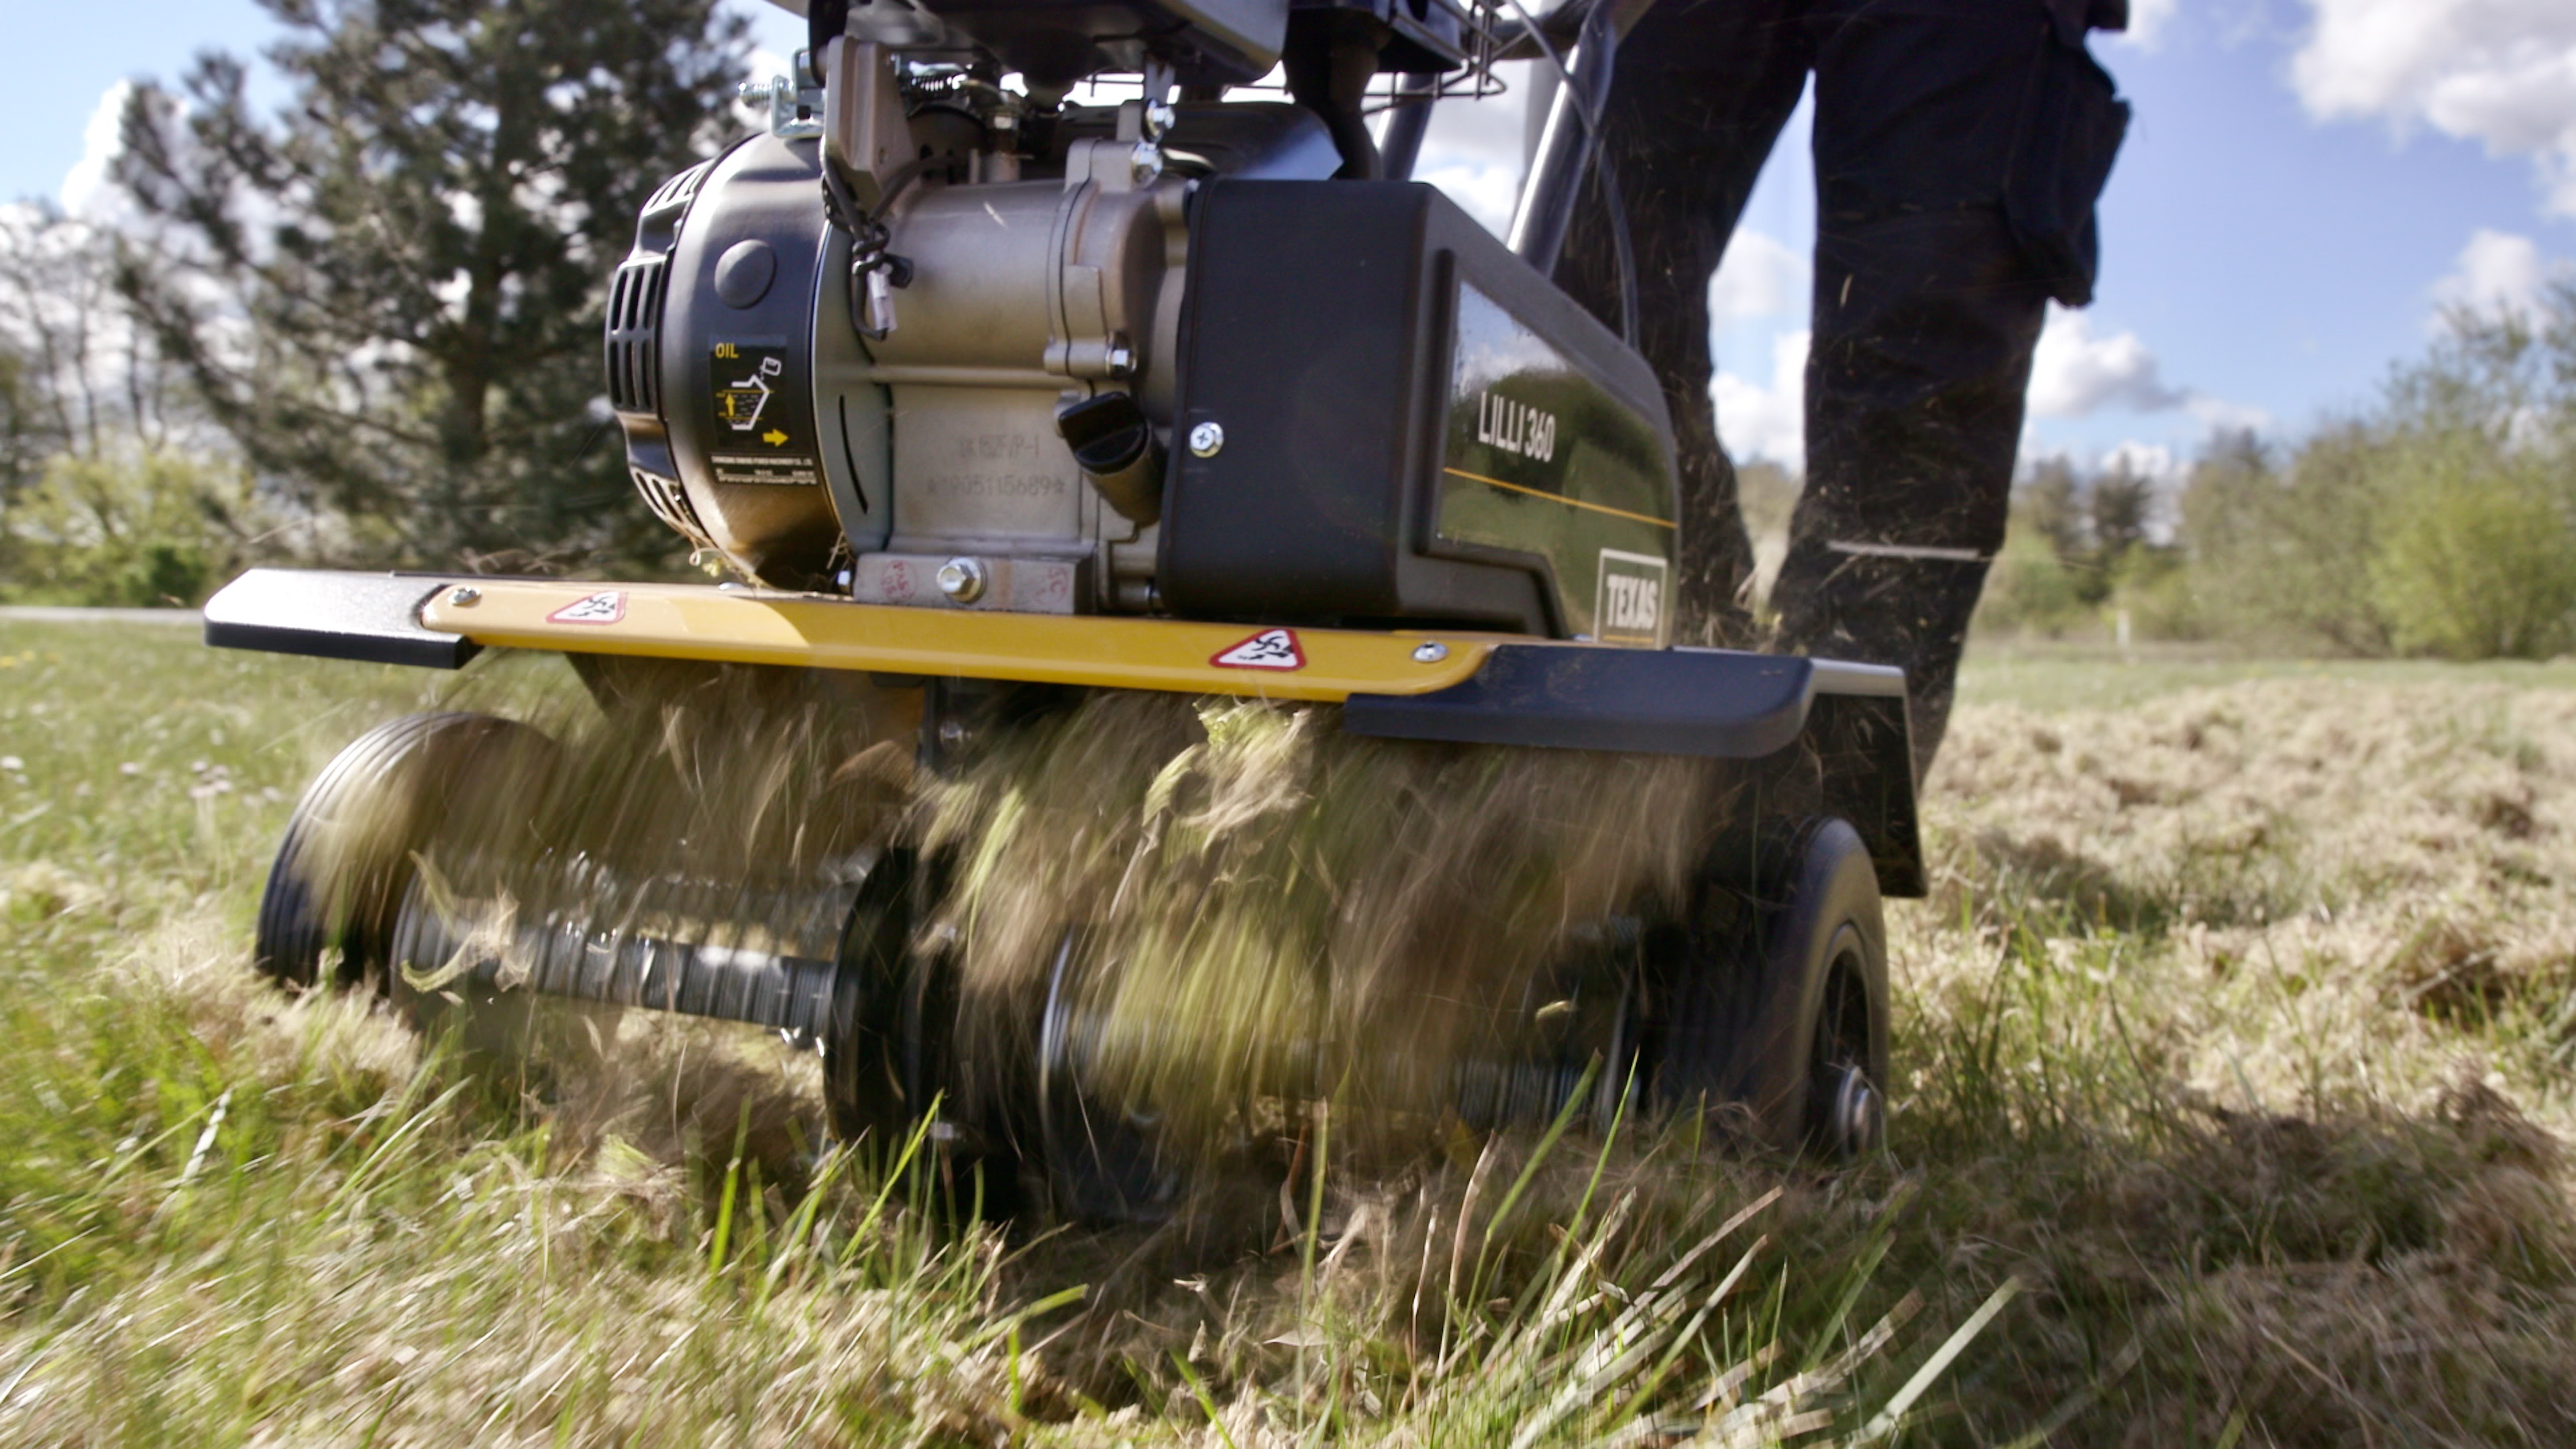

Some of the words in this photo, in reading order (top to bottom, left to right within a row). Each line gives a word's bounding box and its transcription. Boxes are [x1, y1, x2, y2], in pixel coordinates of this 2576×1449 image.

[716, 342, 739, 359] OIL
[1479, 391, 1525, 453] LILLI
[1525, 407, 1556, 462] 360
[1607, 574, 1658, 629] TEXAS
